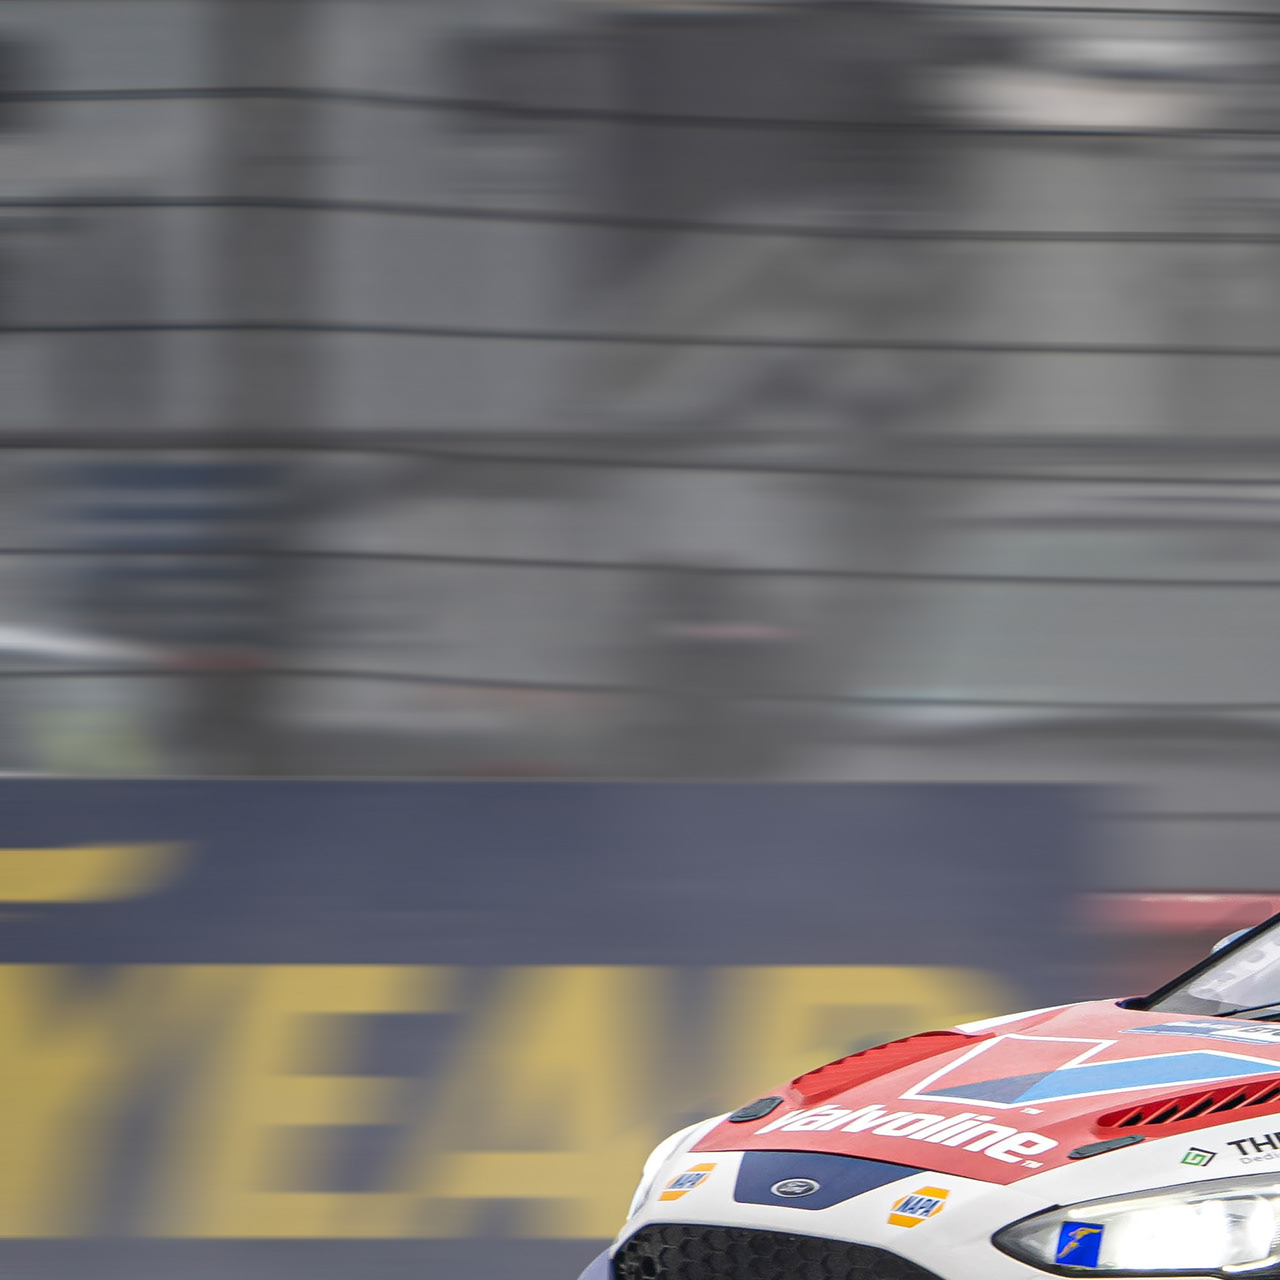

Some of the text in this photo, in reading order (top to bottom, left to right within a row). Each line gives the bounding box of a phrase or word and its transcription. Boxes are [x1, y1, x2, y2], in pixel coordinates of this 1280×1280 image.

[754, 1104, 1060, 1163] Valvoline
[667, 1171, 709, 1191] NAPA
[893, 1197, 941, 1218] NAPA
